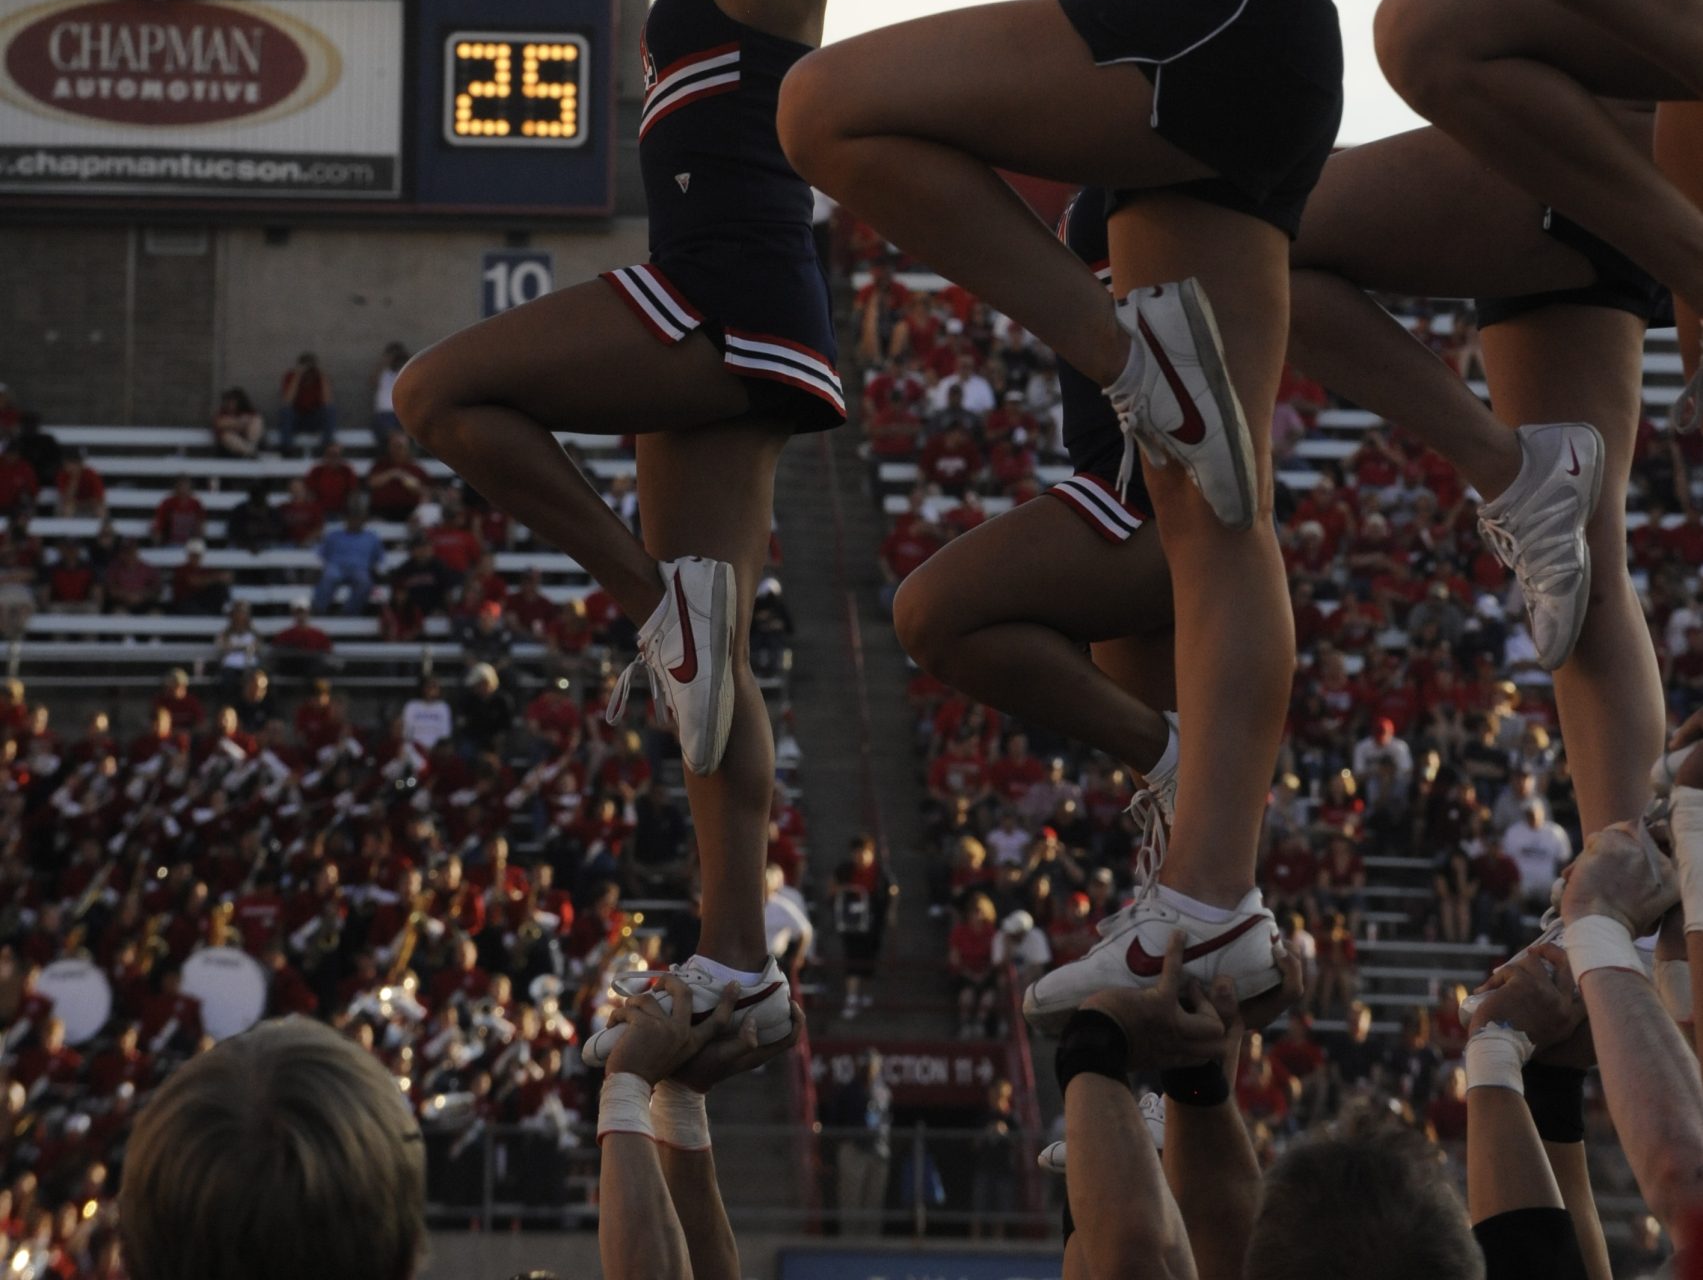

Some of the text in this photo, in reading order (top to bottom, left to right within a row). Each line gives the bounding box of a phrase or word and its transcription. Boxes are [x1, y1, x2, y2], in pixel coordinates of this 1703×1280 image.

[48, 21, 264, 74] CHAPMAN
[53, 76, 260, 104] AUTOMOTIVE
[455, 42, 578, 138] 25
[484, 261, 553, 311] 10
